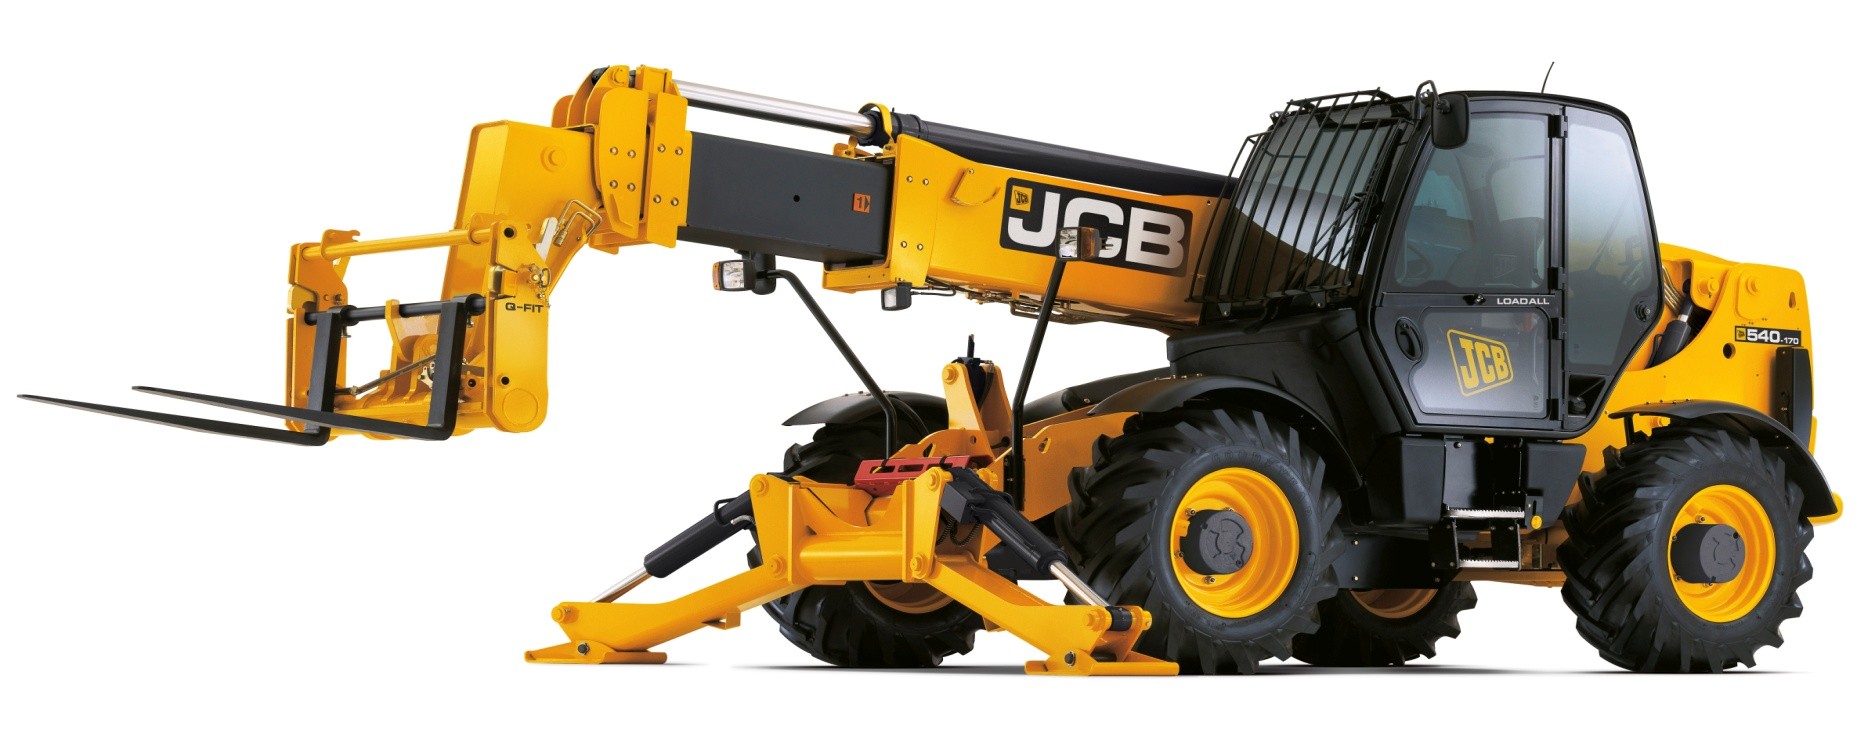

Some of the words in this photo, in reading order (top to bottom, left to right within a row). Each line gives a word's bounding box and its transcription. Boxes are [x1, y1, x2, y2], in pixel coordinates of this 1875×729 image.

[857, 196, 862, 209] 1
[1007, 191, 1185, 269] JCB
[505, 302, 544, 313] Q-FIT
[1496, 297, 1550, 305] LOADALL
[1458, 337, 1509, 389] JCB
